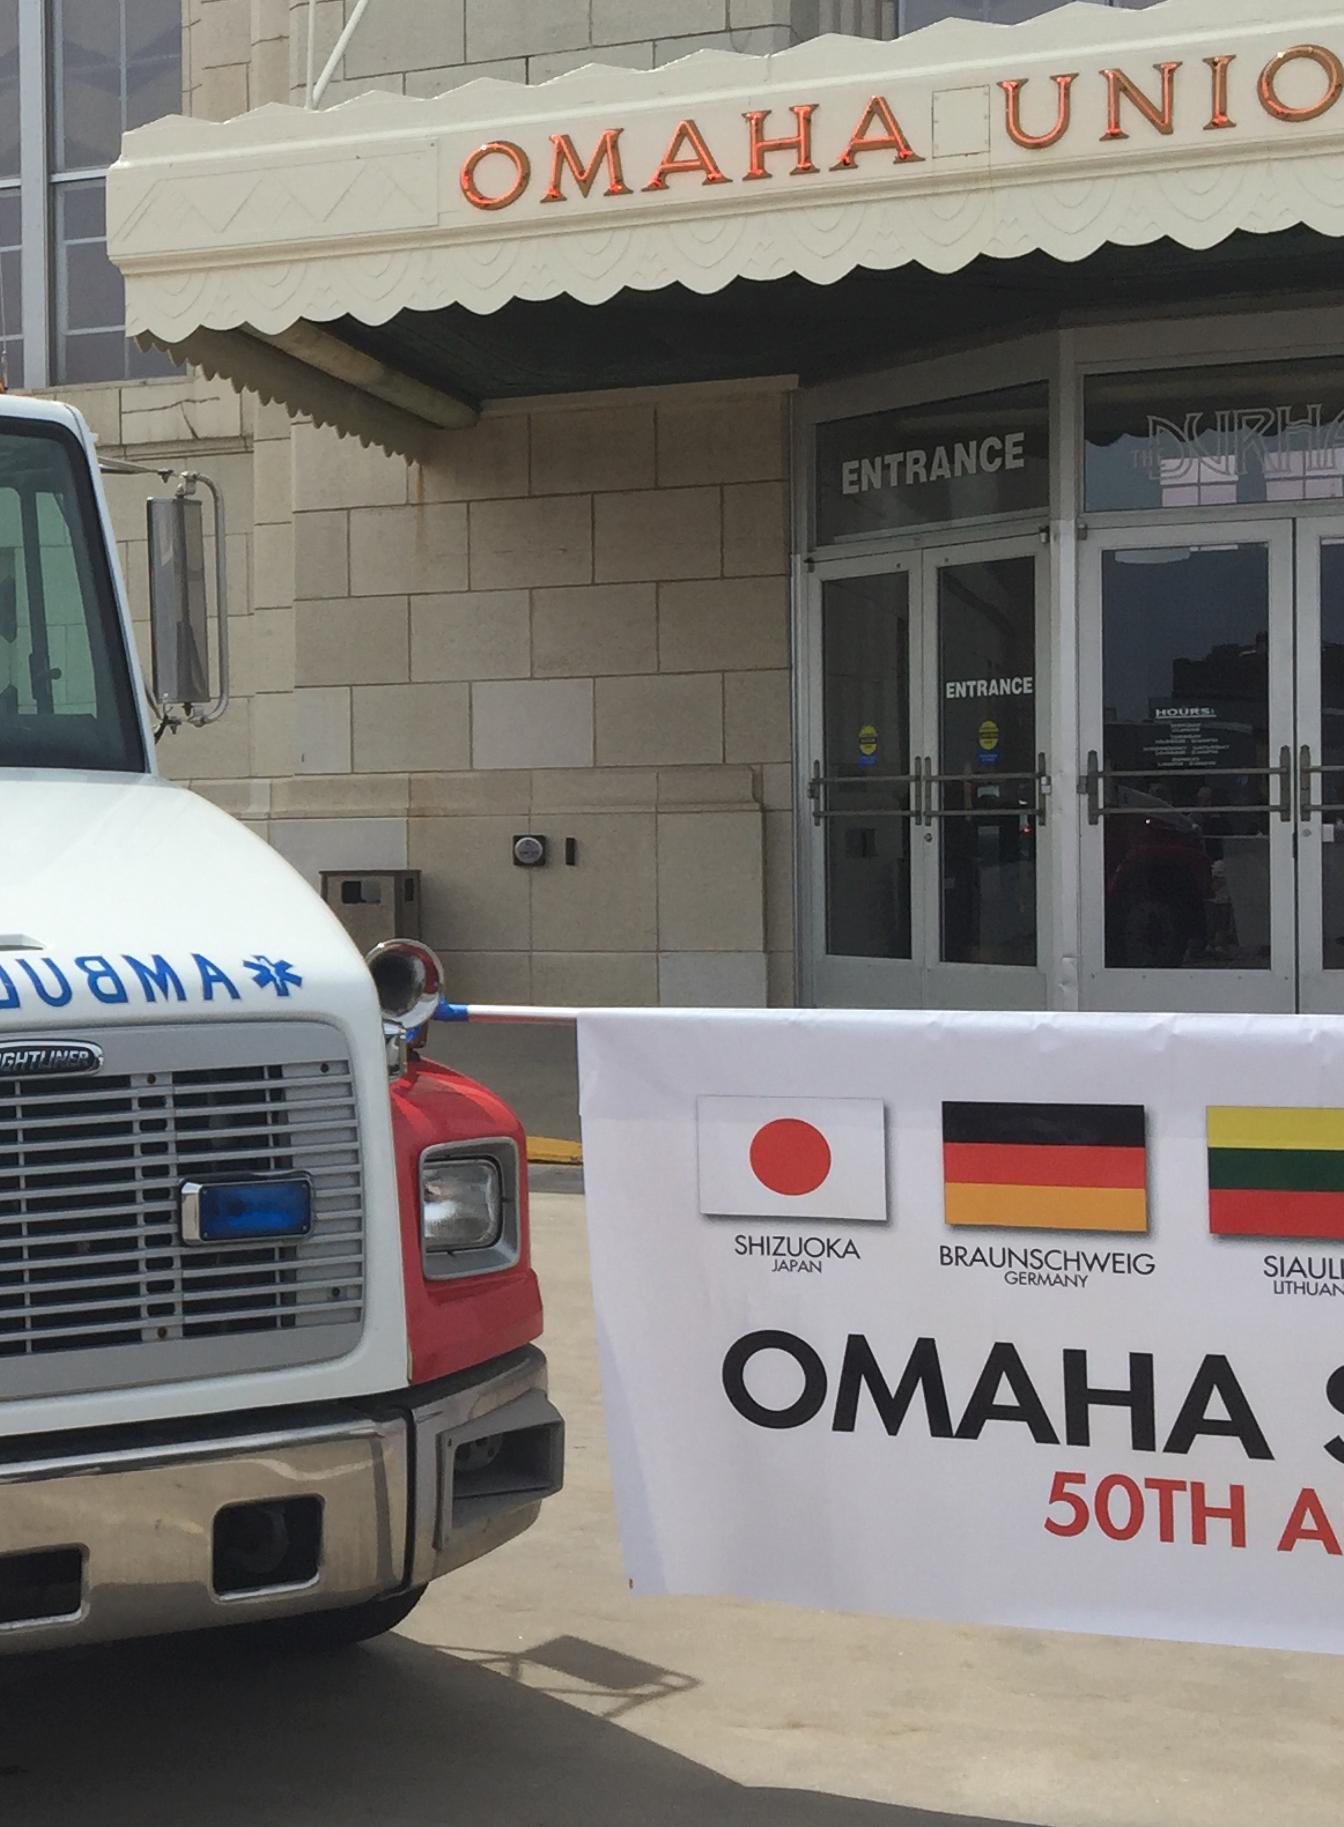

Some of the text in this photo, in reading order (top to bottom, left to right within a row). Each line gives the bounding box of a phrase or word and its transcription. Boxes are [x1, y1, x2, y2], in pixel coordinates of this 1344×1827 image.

[459, 44, 1344, 211] OMAHA UNIO
[842, 432, 1025, 495] ENTRANCE
[945, 677, 1033, 699] ENTRANCE
[734, 1234, 860, 1260] SHIZUOKA
[939, 1245, 1156, 1276] BRAUNSCHWEIG
[772, 1258, 822, 1274] JAPAN
[1004, 1271, 1088, 1288] GERMANY
[722, 1329, 1276, 1461] OMAHA
[1045, 1471, 1247, 1548] 50TH
